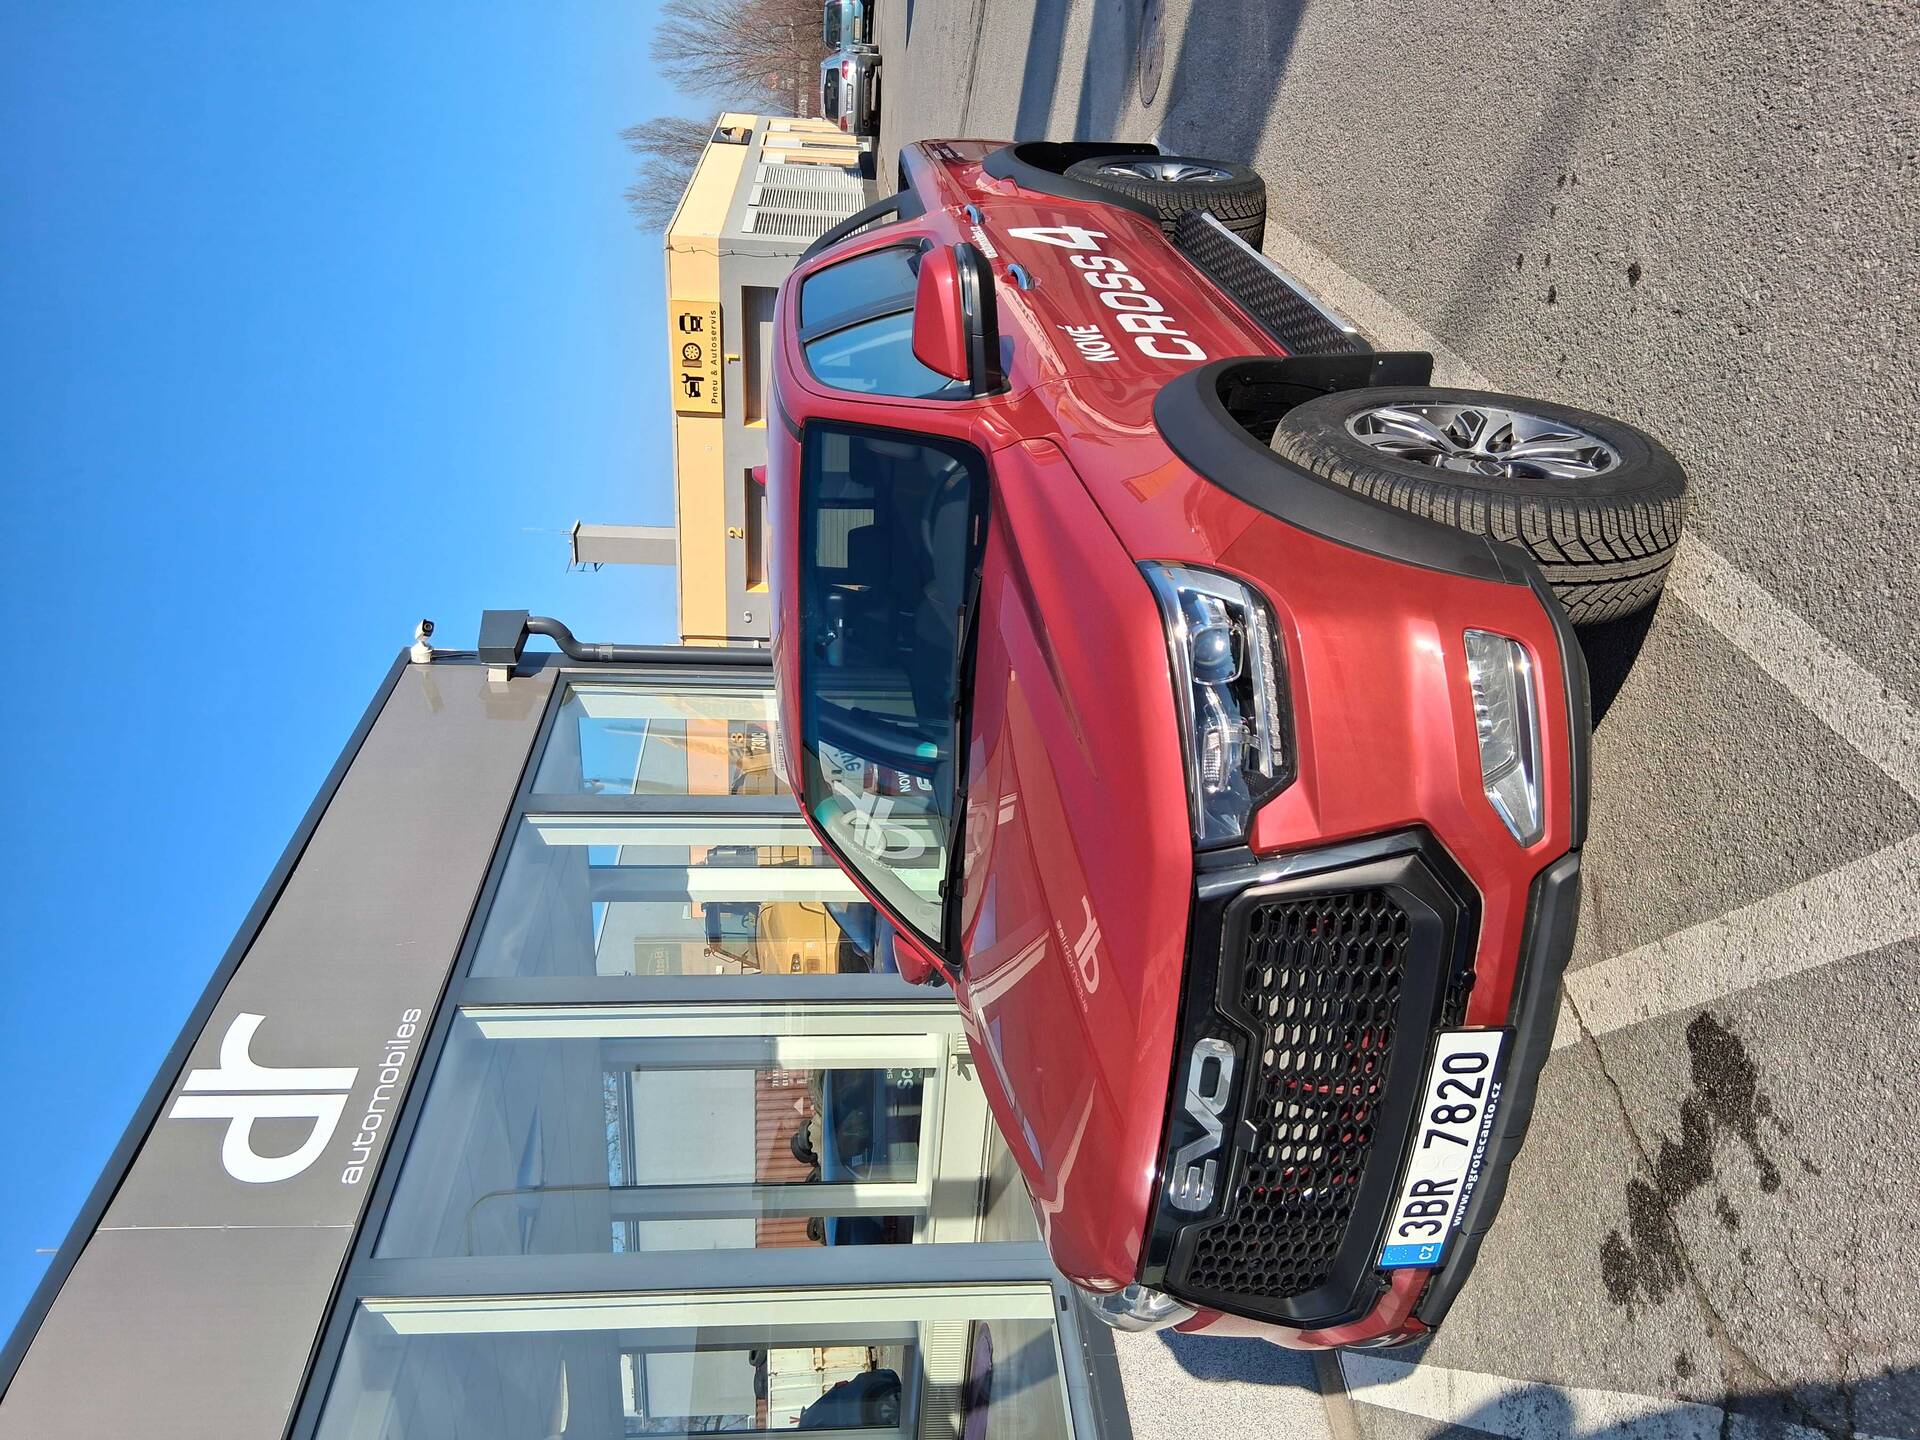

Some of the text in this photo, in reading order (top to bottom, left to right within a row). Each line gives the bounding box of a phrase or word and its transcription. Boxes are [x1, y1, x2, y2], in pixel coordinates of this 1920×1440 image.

[1007, 226, 1108, 251] 4
[1070, 255, 1208, 360] CROSS
[709, 310, 717, 365] Autoservis
[726, 354, 740, 364] 1
[1056, 324, 1120, 362] NOVÉ
[728, 527, 744, 540] 2
[341, 1008, 422, 1184] automobiles
[1169, 1038, 1236, 1211] EVO
[1398, 1053, 1489, 1237] 3BR 7820
[1452, 1082, 1502, 1227] www.agrotecauto.cz
[1418, 1245, 1434, 1260] CZ
